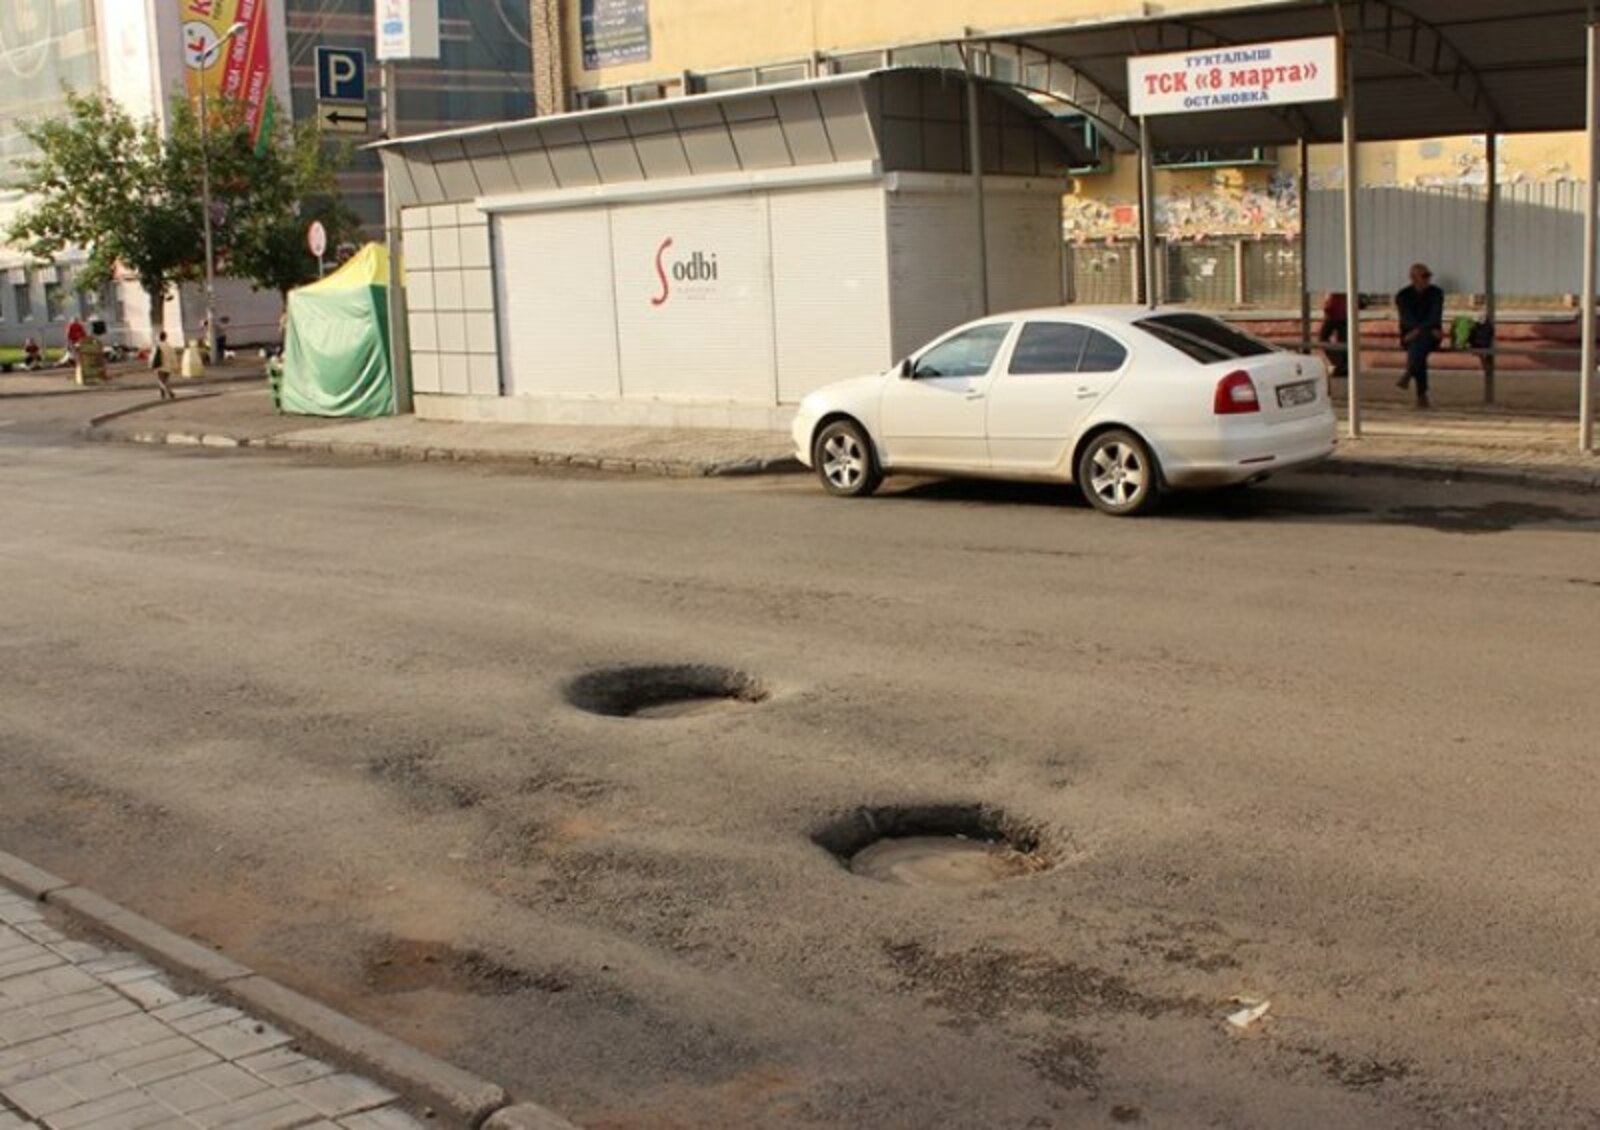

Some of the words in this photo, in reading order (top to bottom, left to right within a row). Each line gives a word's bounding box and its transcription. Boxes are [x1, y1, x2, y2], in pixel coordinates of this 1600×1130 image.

[328, 54, 356, 95] P
[1145, 71, 1187, 95] ТСК
[1195, 68, 1222, 90] «8
[1229, 62, 1318, 90] марта»
[1184, 91, 1269, 108] ОСТАНОВКА
[651, 237, 717, 305] Sodbi
